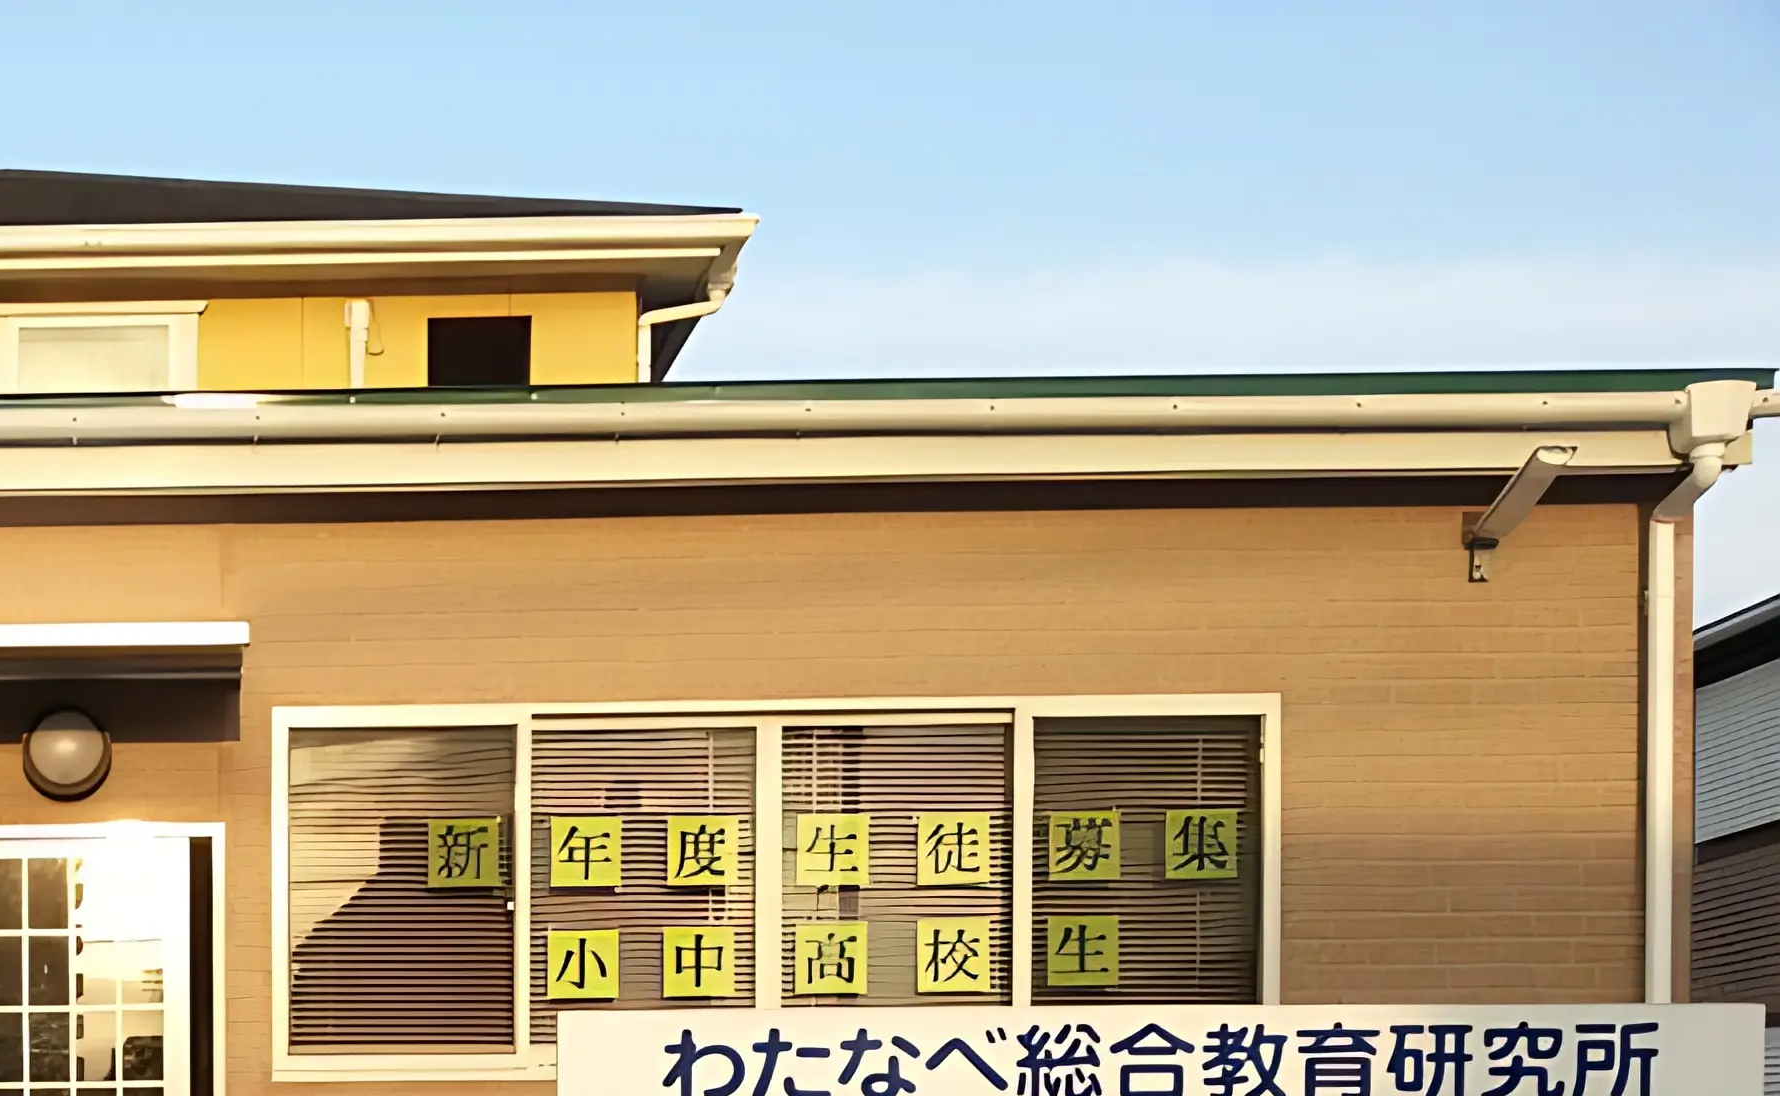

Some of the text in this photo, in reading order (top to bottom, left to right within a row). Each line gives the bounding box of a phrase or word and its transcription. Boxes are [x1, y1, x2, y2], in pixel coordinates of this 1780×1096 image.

[438, 814, 1230, 880] 新年度生徒募集
[555, 923, 1109, 987] 小中高校生
